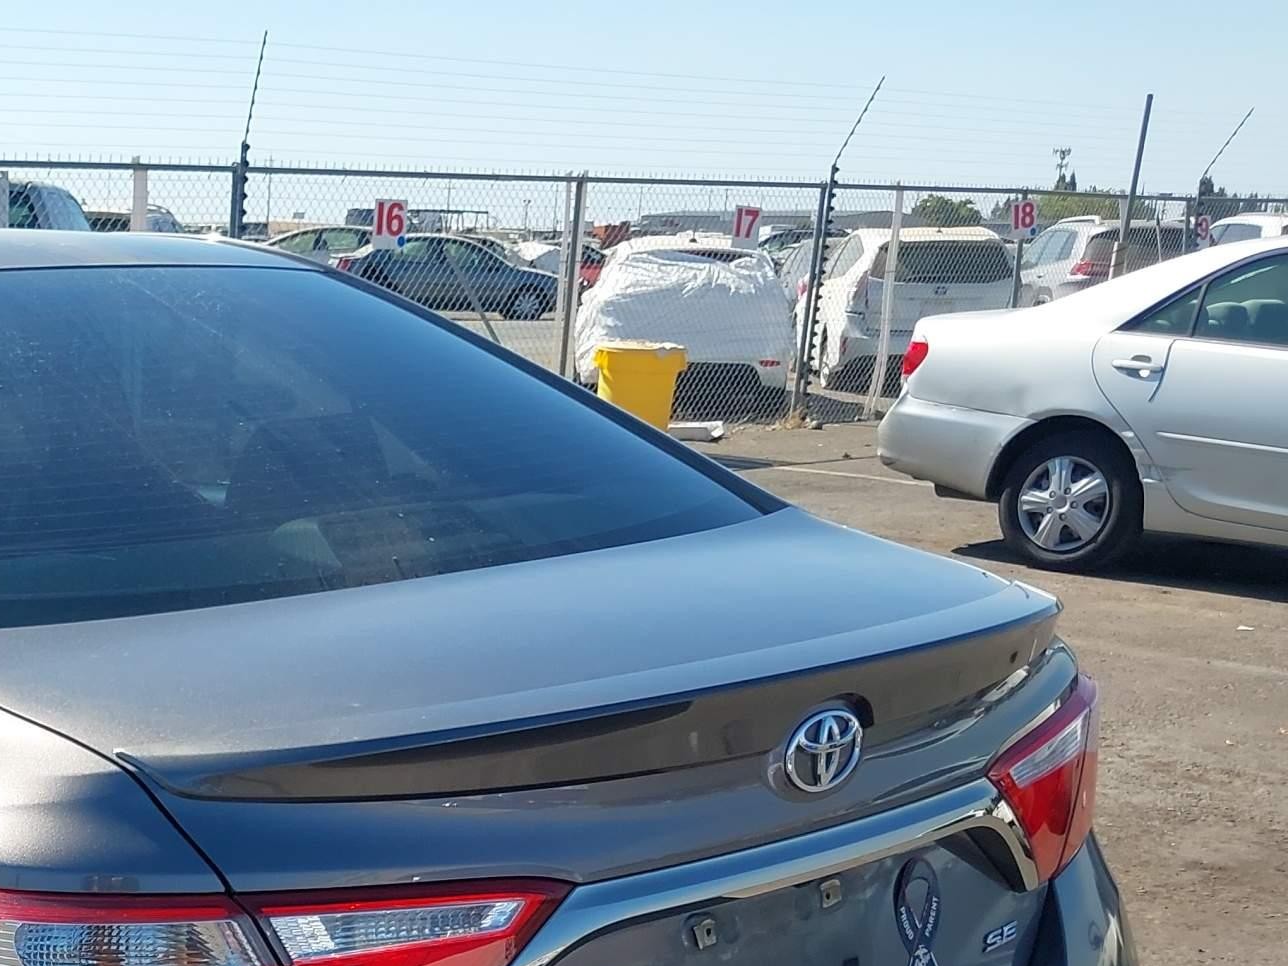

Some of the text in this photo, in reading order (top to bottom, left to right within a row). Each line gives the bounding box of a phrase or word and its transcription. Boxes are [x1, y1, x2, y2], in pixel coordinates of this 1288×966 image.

[376, 201, 404, 236] 16
[734, 207, 760, 239] 17
[1013, 202, 1035, 230] 18
[899, 905, 915, 941] PROUD
[924, 895, 940, 938] PARENT
[982, 919, 1019, 953] SE
